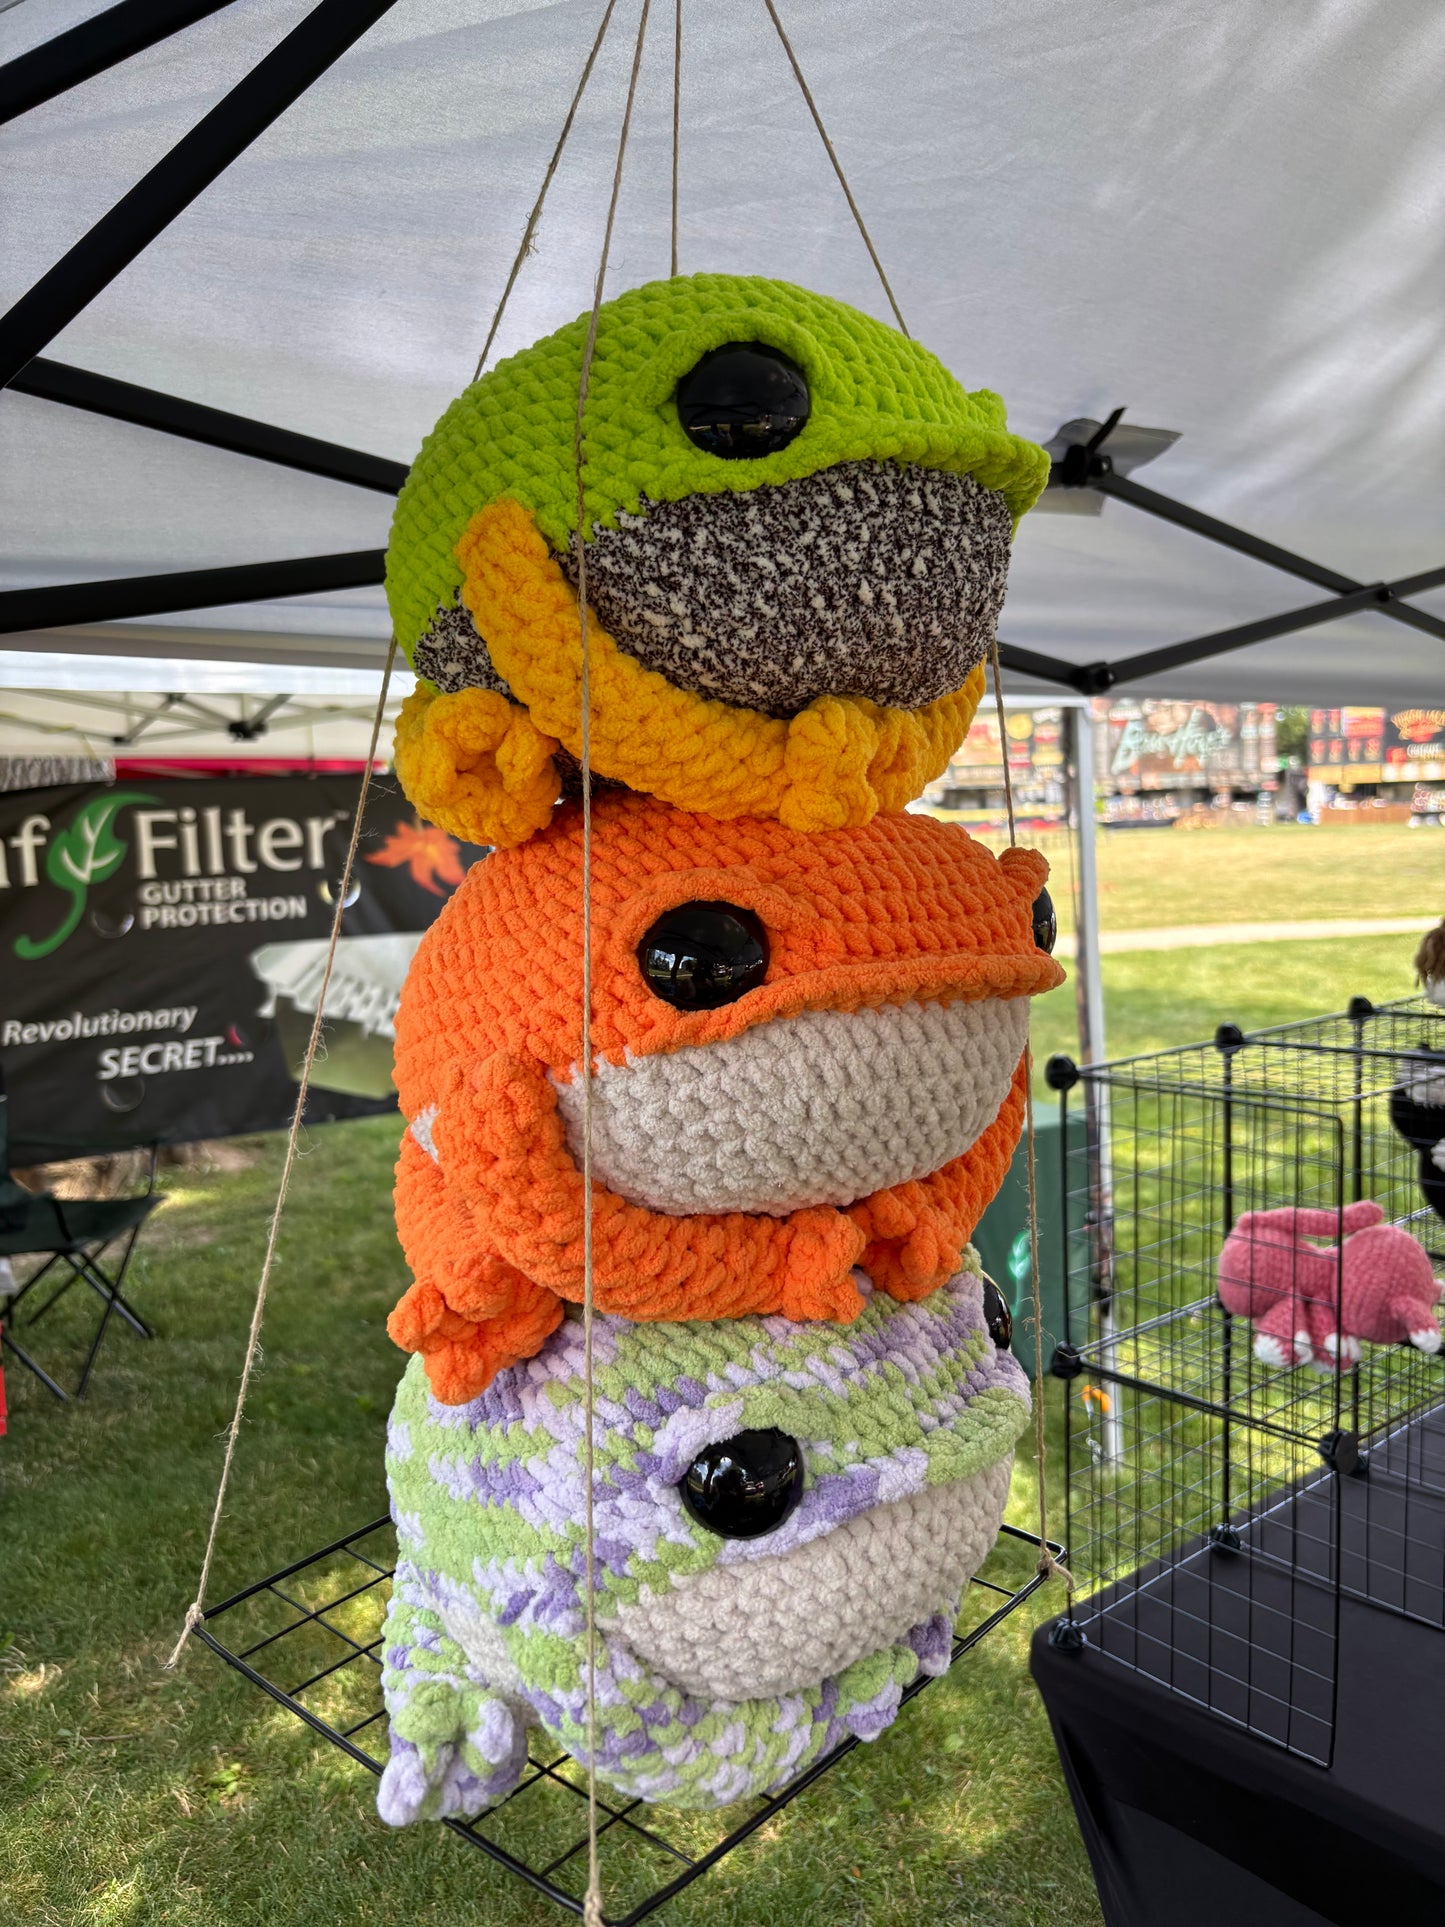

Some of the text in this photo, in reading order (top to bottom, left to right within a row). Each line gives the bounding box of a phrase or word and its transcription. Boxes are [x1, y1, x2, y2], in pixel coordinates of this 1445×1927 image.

[140, 876, 247, 905] GUTTER
[139, 896, 307, 930] PROTECTION
[2, 1006, 198, 1046] Revolutionary
